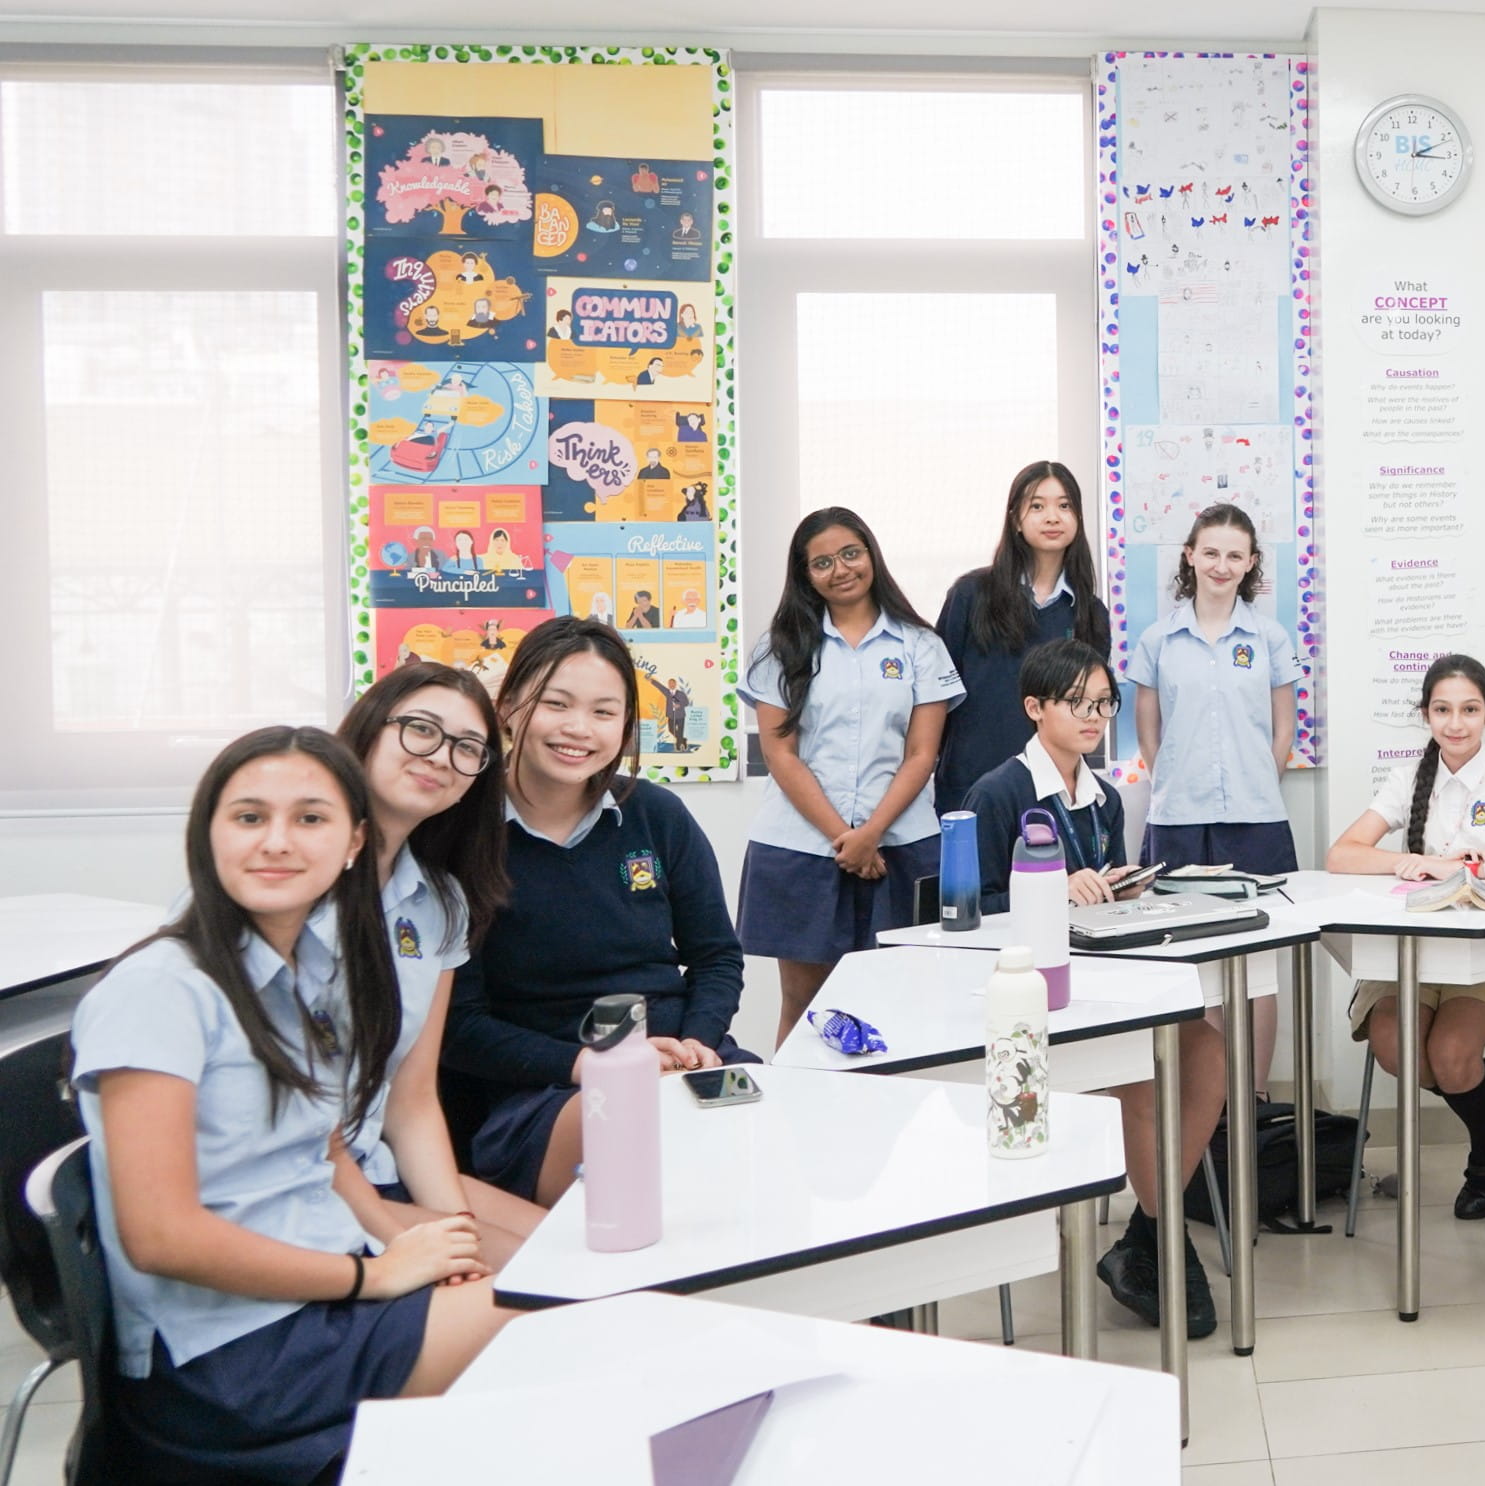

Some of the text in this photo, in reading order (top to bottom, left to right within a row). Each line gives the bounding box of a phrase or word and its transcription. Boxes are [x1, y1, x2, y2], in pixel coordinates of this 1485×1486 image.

[1392, 121, 1400, 129] 11
[1408, 116, 1417, 124] 12
[1380, 134, 1390, 142] 10
[1395, 135, 1431, 154] BIS
[387, 175, 472, 196] Knowledgeable
[1394, 280, 1428, 292] What
[575, 295, 672, 320] COMMUN
[1374, 296, 1449, 311] CONCEPT
[1361, 313, 1461, 327] are you looking
[578, 319, 669, 344] ICATORS
[1381, 328, 1442, 342] at today?
[1386, 368, 1440, 378] Causation
[556, 433, 623, 468] Think
[586, 463, 622, 487] ers
[1380, 466, 1446, 476] Significance
[627, 534, 704, 557] Reflective
[1391, 559, 1438, 570] Evidence
[414, 572, 500, 601] Principled
[1389, 650, 1430, 661] Change
[632, 655, 657, 680] ing
